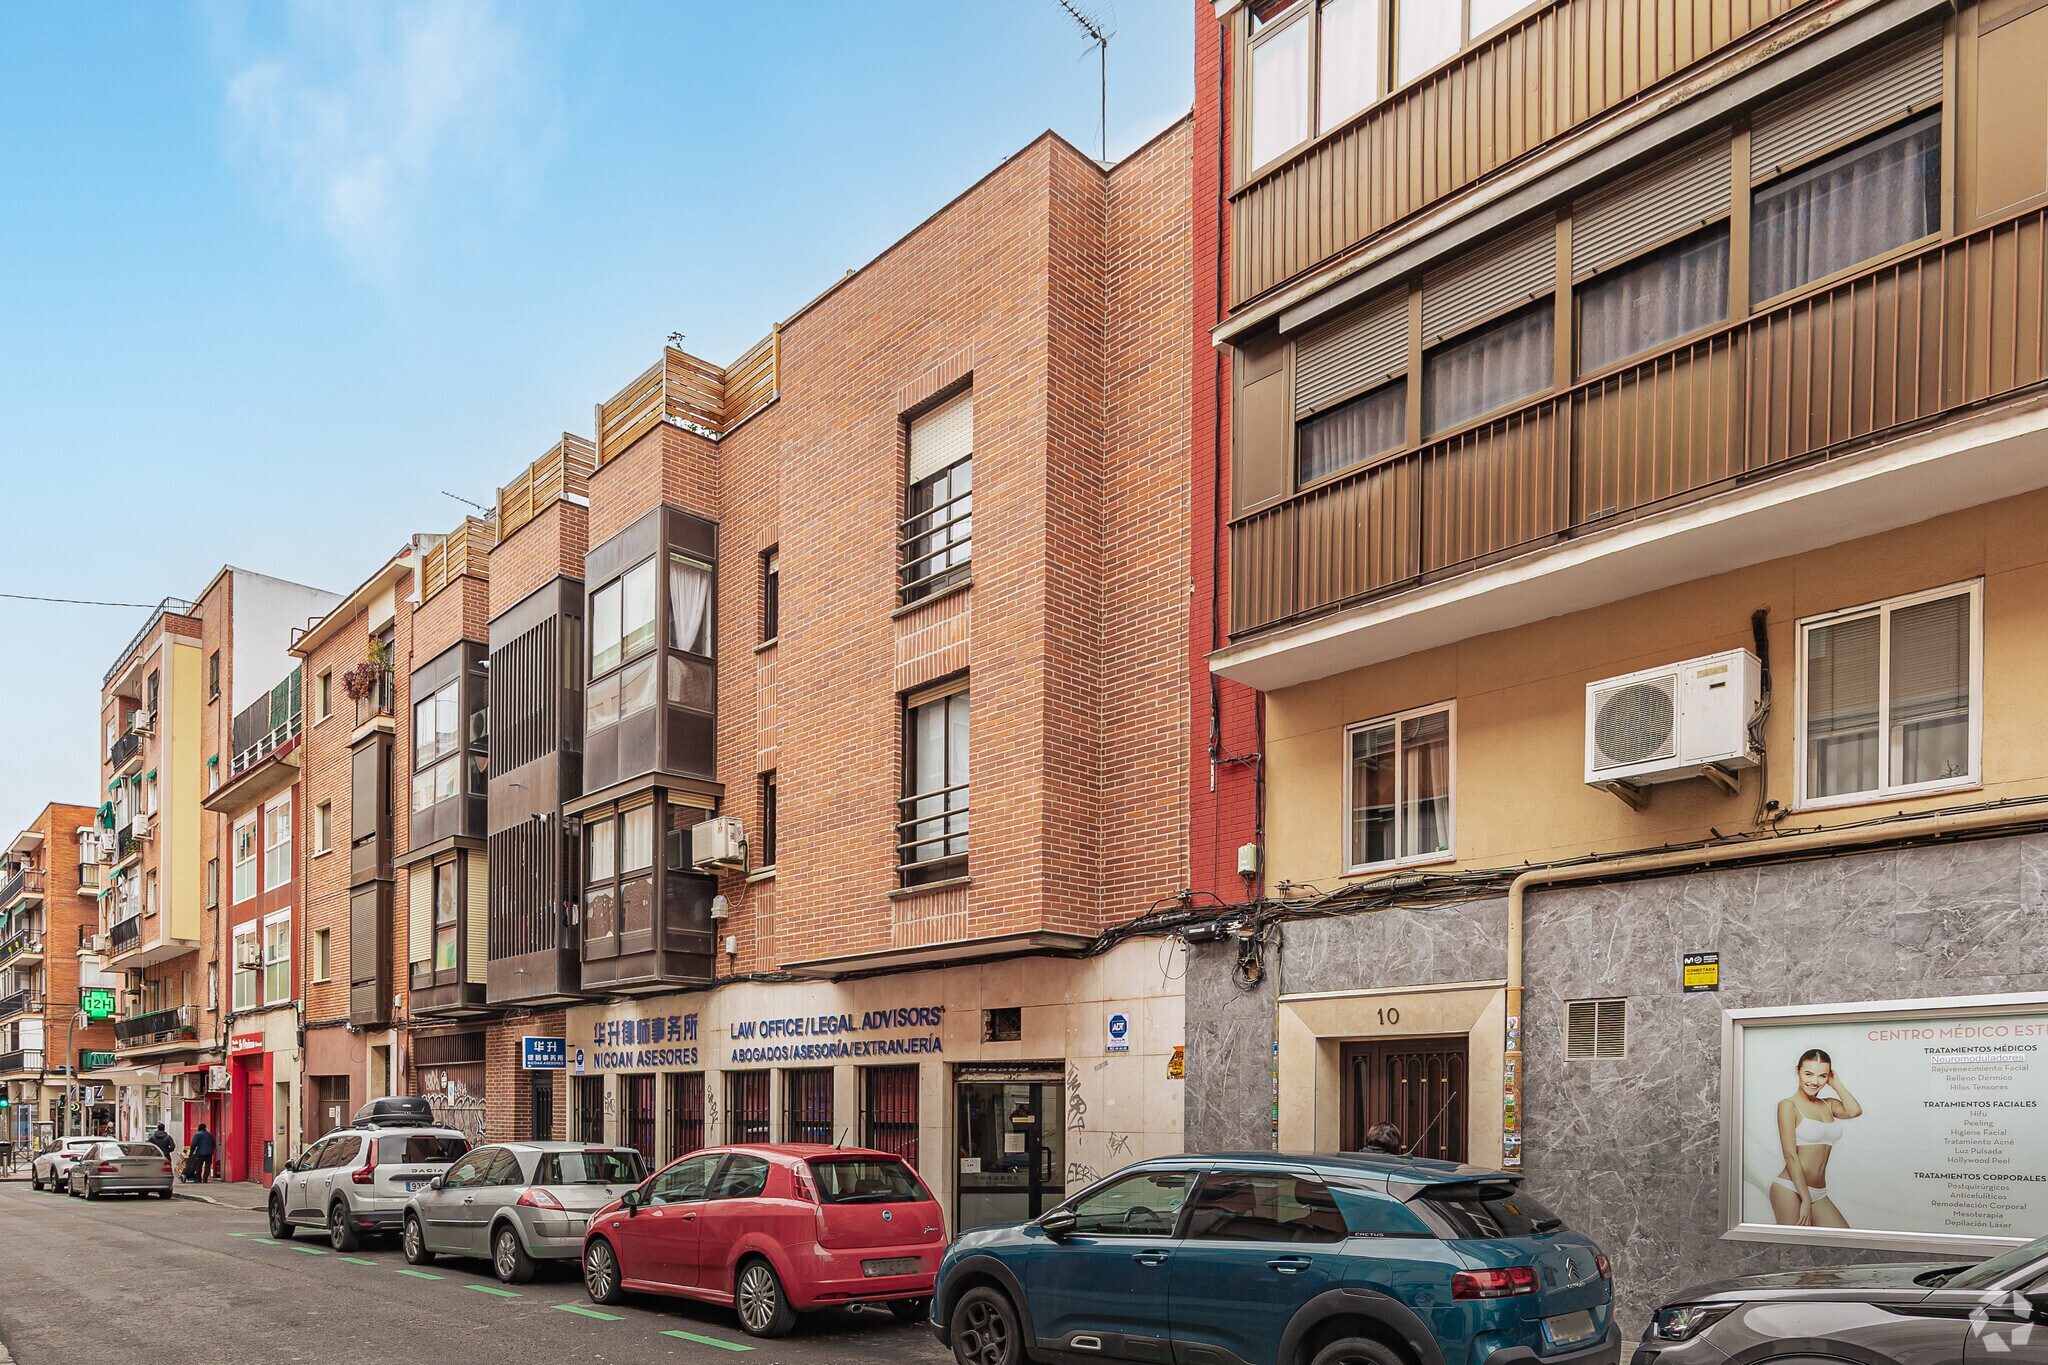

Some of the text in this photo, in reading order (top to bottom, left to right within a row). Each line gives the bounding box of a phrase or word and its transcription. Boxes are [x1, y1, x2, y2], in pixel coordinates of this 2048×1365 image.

[87, 999, 111, 1009] 12H
[1377, 1007, 1399, 1025] 10
[730, 1006, 942, 1040] LAW OFFICE/LEGAL ADVISORS
[1112, 1022, 1125, 1032] ADT
[1867, 1024, 2048, 1041] CENTRO MÉDICO EST
[533, 1041, 557, 1052] 华升
[731, 1032, 944, 1063] ABOGADOS/ASESORÍA/EXTRANJERÍA
[1924, 1043, 2038, 1054] TRATAMIENTOS MÉDICOS
[593, 1047, 698, 1069] NICOAN ASESORES
[1931, 1054, 2025, 1063] Neuromoduladores
[1931, 1064, 2029, 1073] Rejuvenecimiento Facial
[1946, 1074, 1976, 1082] Relleno
[1923, 1100, 2037, 1108] TRATAMIENTOS FACIALES
[1963, 1119, 1994, 1128] Peeling
[1950, 1129, 1981, 1137] Higiene
[1993, 1138, 2015, 1146] Acné
[1947, 1157, 1990, 1165] Hollywood
[1913, 1172, 2047, 1182] TRATAMIENTOS CORPORALES
[411, 1182, 430, 1190] 935
[1947, 1182, 2010, 1191] Postquirúrgicos
[1949, 1192, 2007, 1200] Anticelulíticos
[1931, 1200, 2027, 1211] Remodelación Corporal
[1953, 1210, 2004, 1219] Mesoterapia
[1944, 1219, 1987, 1228] Depilación
